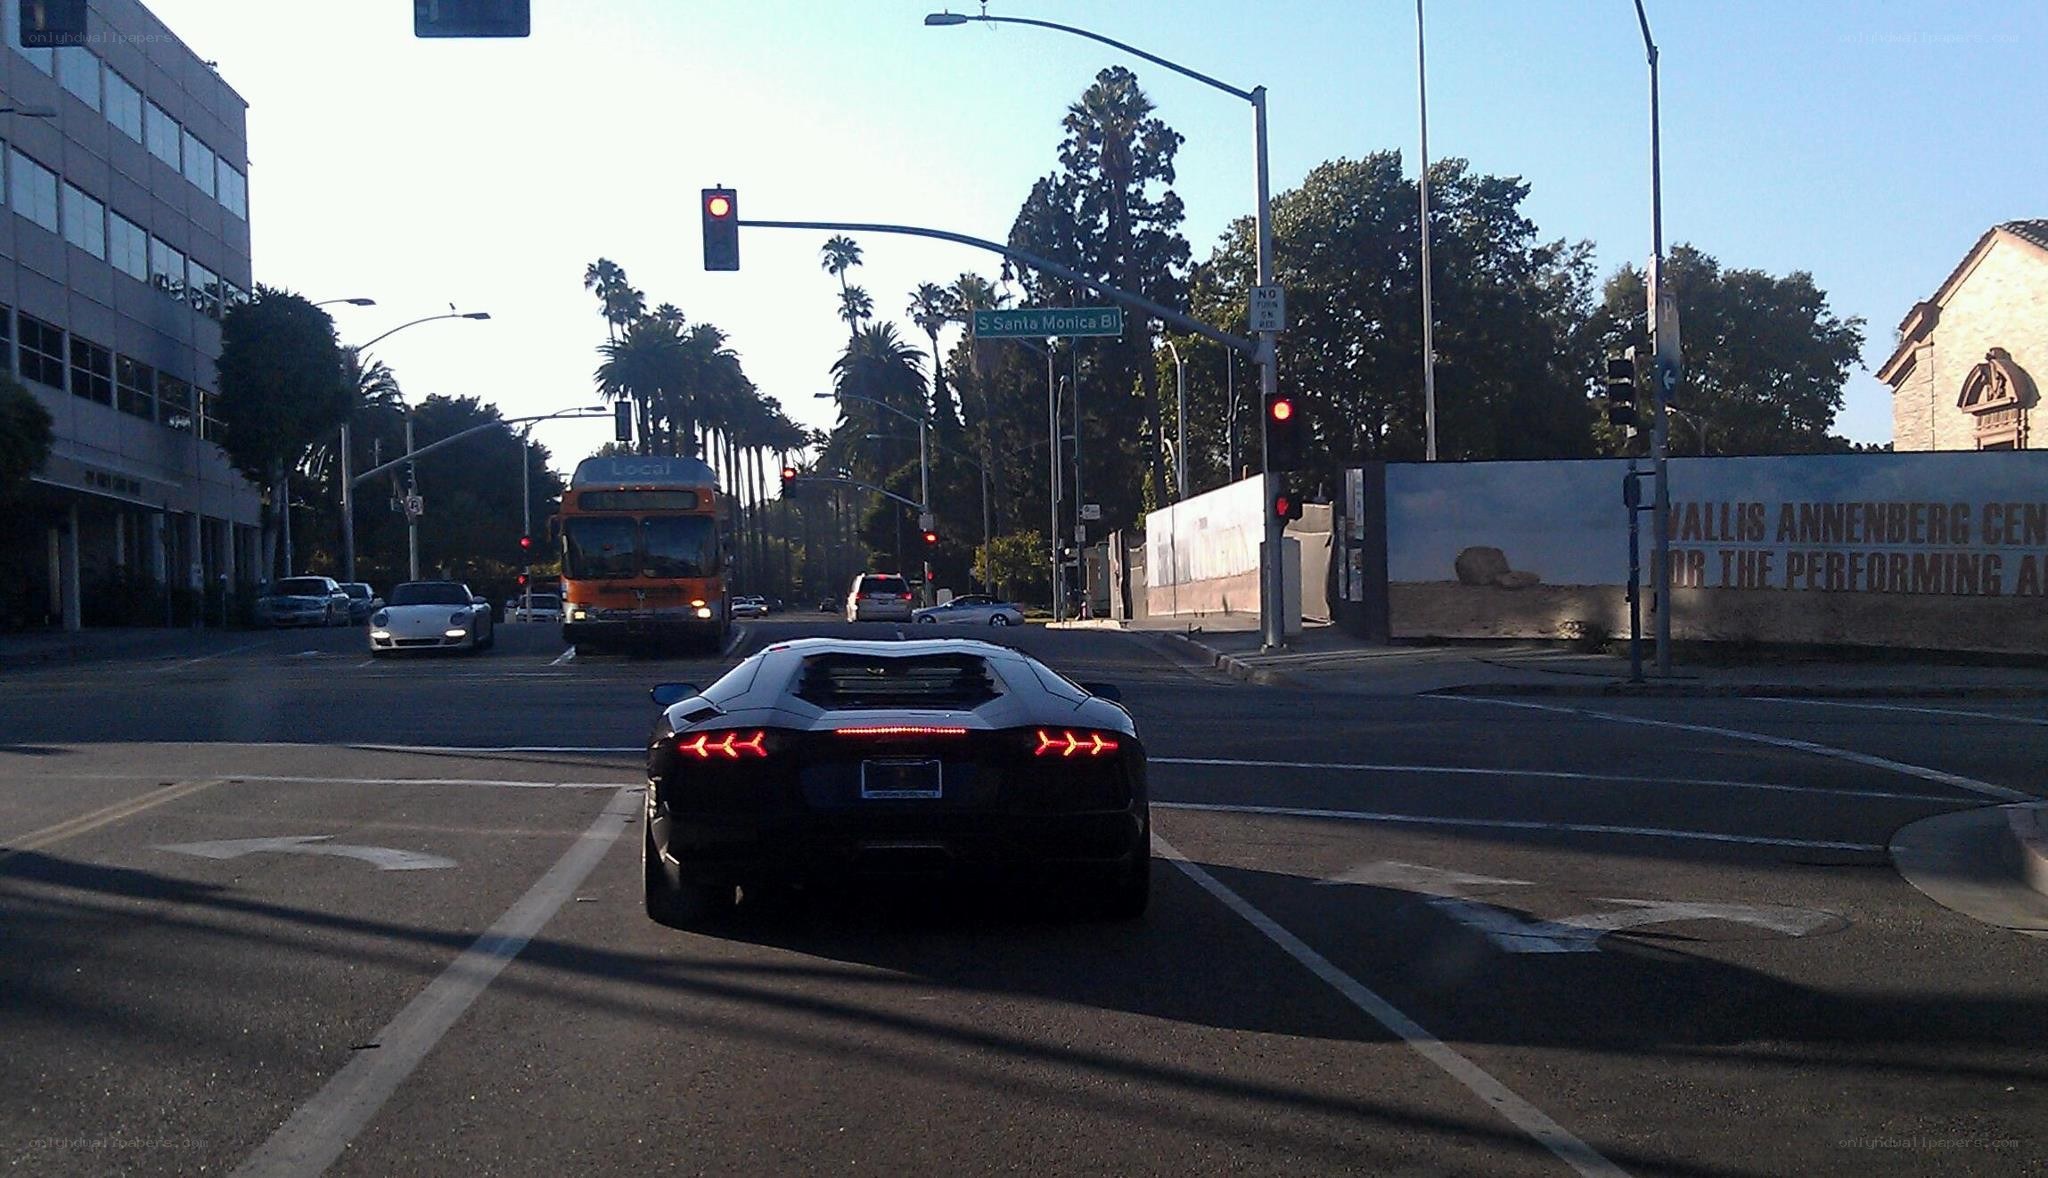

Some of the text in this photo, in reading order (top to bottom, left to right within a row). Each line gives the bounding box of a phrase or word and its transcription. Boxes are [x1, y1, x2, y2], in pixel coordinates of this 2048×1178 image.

[1259, 289, 1276, 299] NO
[979, 317, 989, 330] S
[994, 316, 1038, 330] Santa
[1043, 315, 1096, 330] Monica
[612, 460, 669, 476] Local
[1776, 502, 1970, 545] ANNENBERG
[1718, 550, 1774, 590] THE
[1786, 551, 2002, 595] PERFORMING
